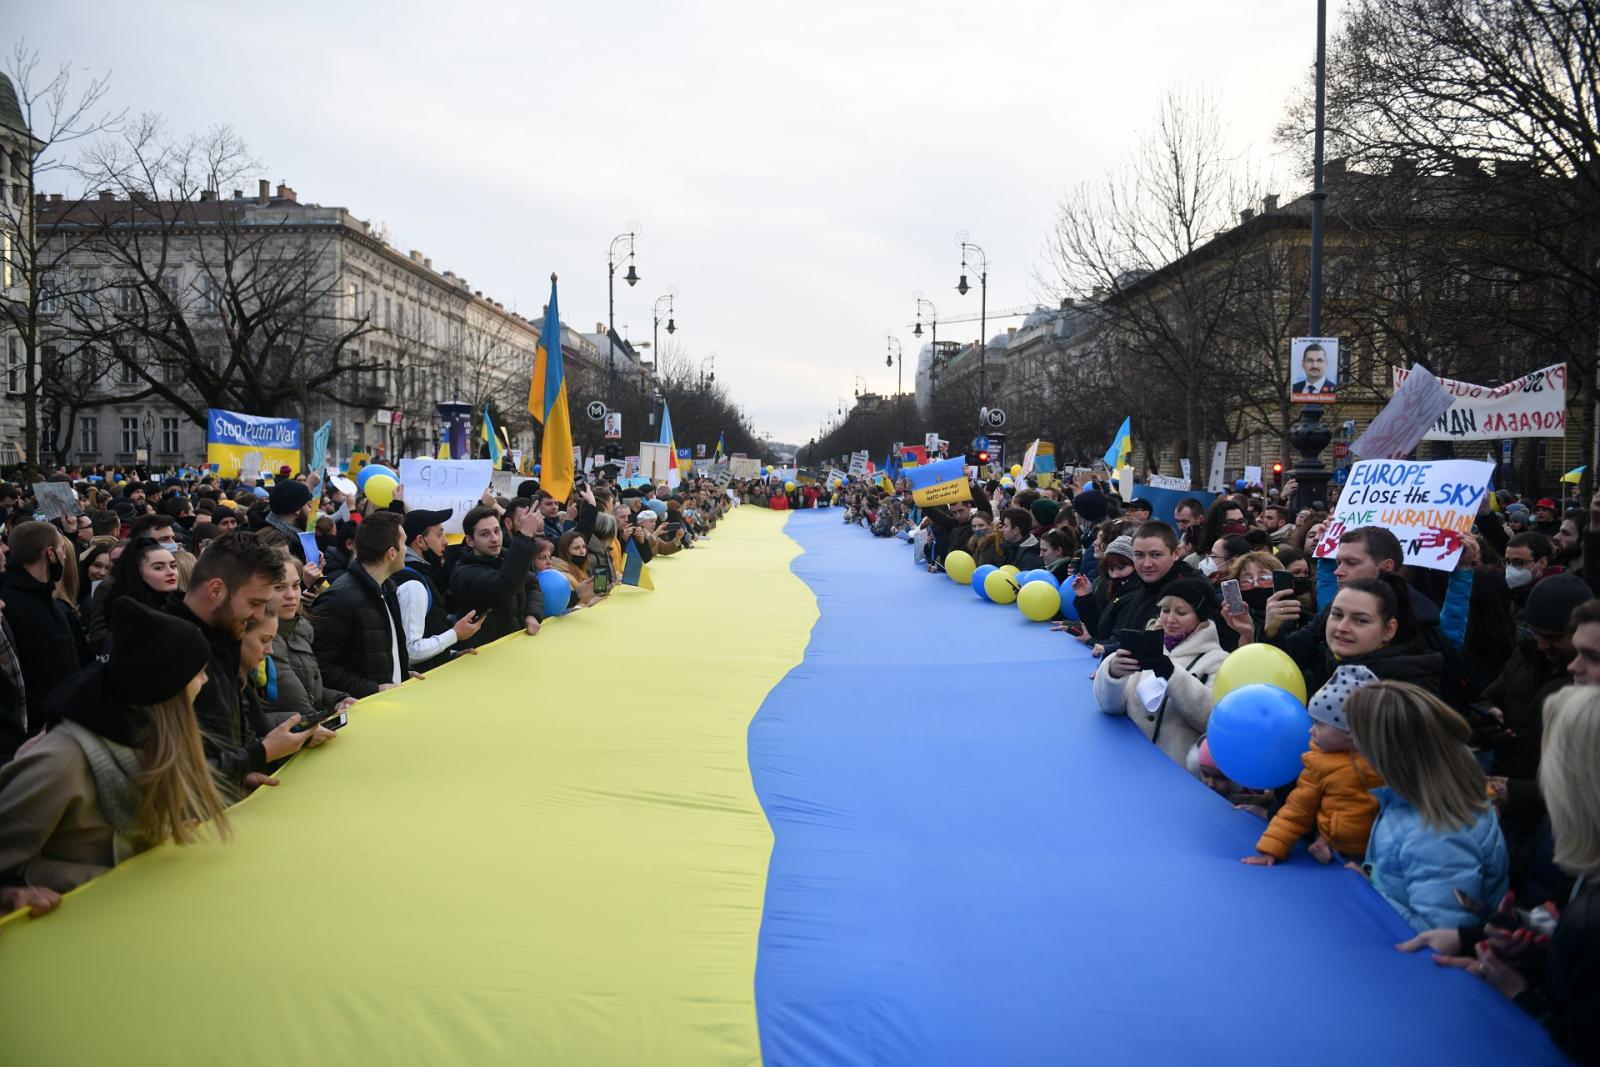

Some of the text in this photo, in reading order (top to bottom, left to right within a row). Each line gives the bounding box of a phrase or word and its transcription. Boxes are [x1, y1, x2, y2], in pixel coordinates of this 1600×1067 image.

[215, 417, 242, 441] Stop
[244, 422, 273, 440] Putin
[275, 424, 296, 442] War
[1335, 446, 1347, 456] STOP
[1350, 464, 1432, 486] EUROPE
[1433, 483, 1486, 507] SKY
[1338, 509, 1475, 531] SAVE UKRAINIAN
